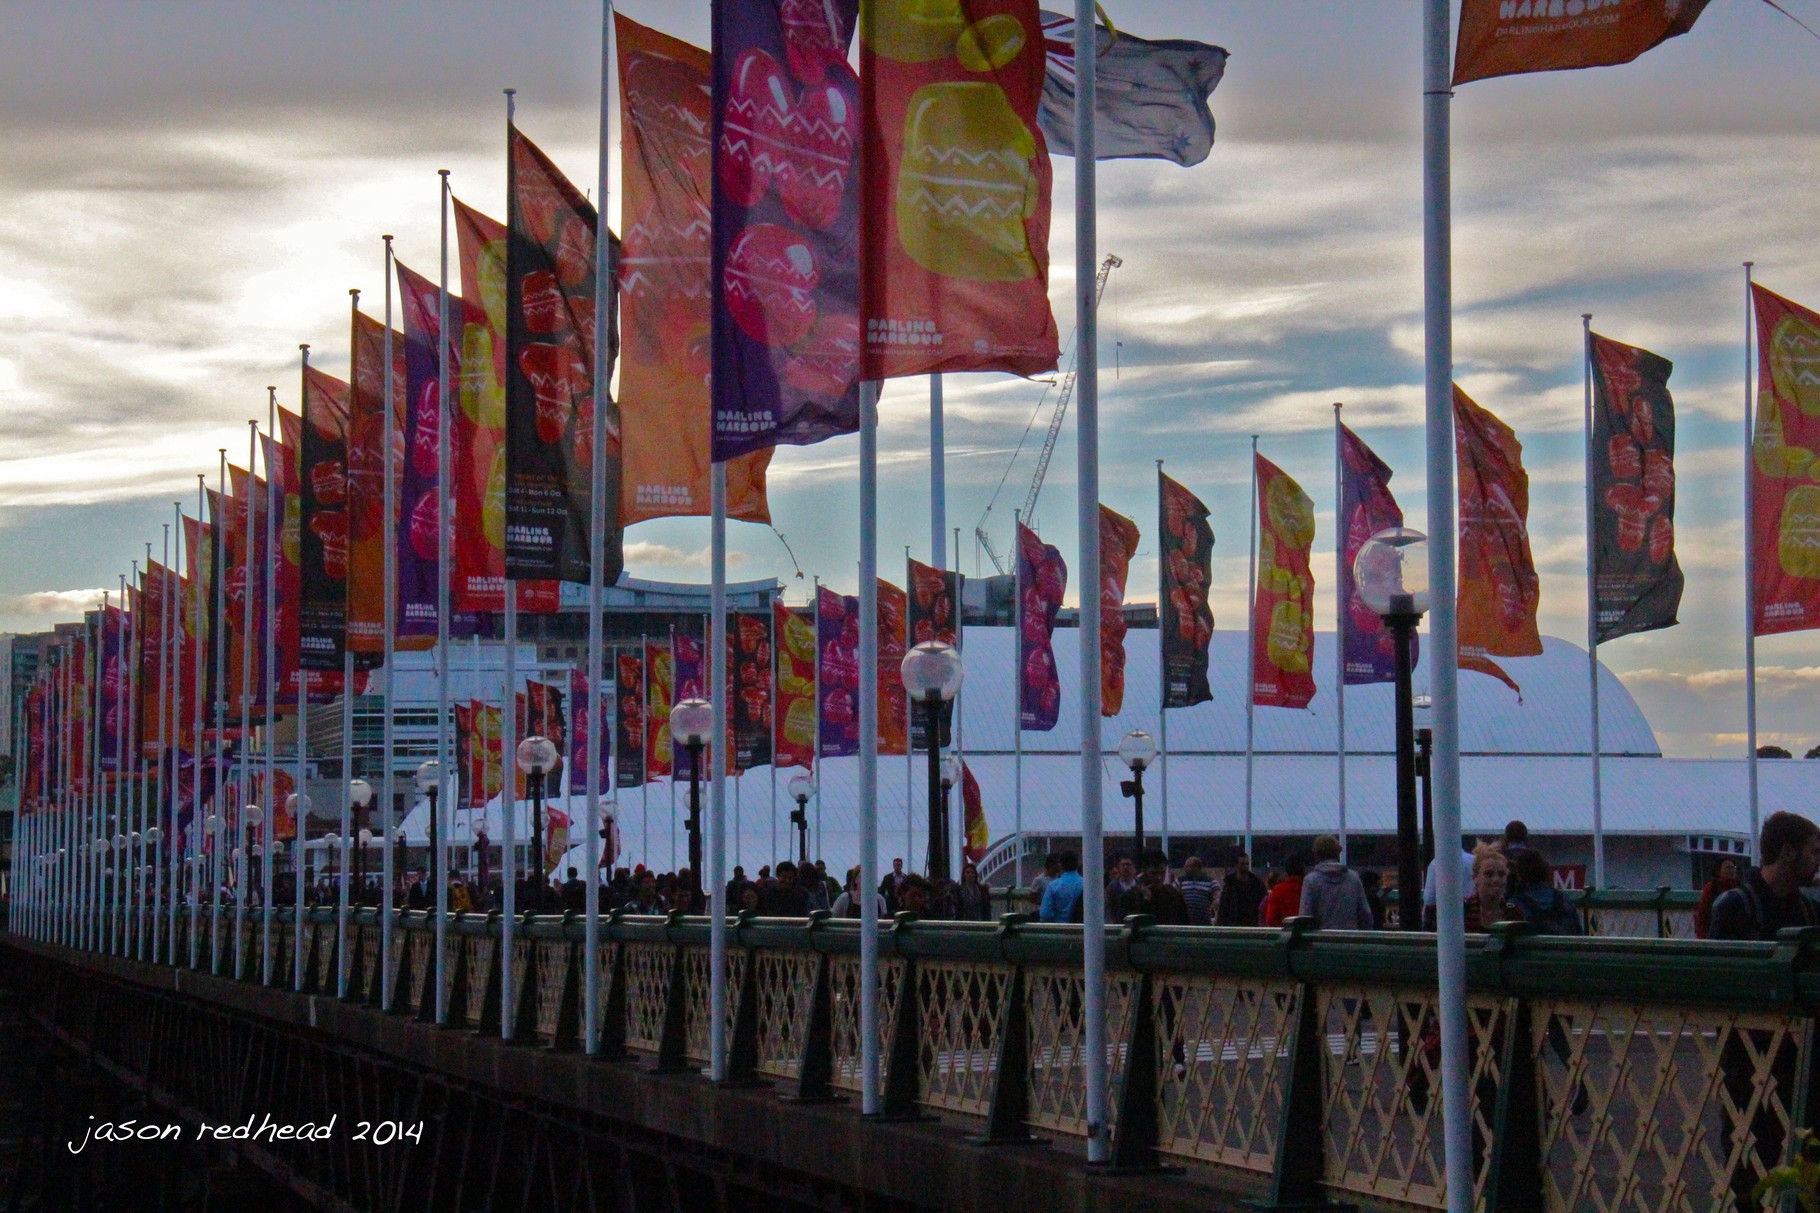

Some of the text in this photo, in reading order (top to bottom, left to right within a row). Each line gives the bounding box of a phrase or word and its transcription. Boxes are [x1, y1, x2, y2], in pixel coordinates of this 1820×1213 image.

[867, 318, 936, 332] DARLING
[867, 332, 943, 345] HARBOUR
[716, 410, 773, 421] DARLING
[716, 421, 777, 432] HARBOUR
[637, 485, 689, 496] DARLING
[636, 495, 693, 506] HARBOUR
[507, 525, 549, 536] DARLING
[507, 534, 553, 544] HARBOUR
